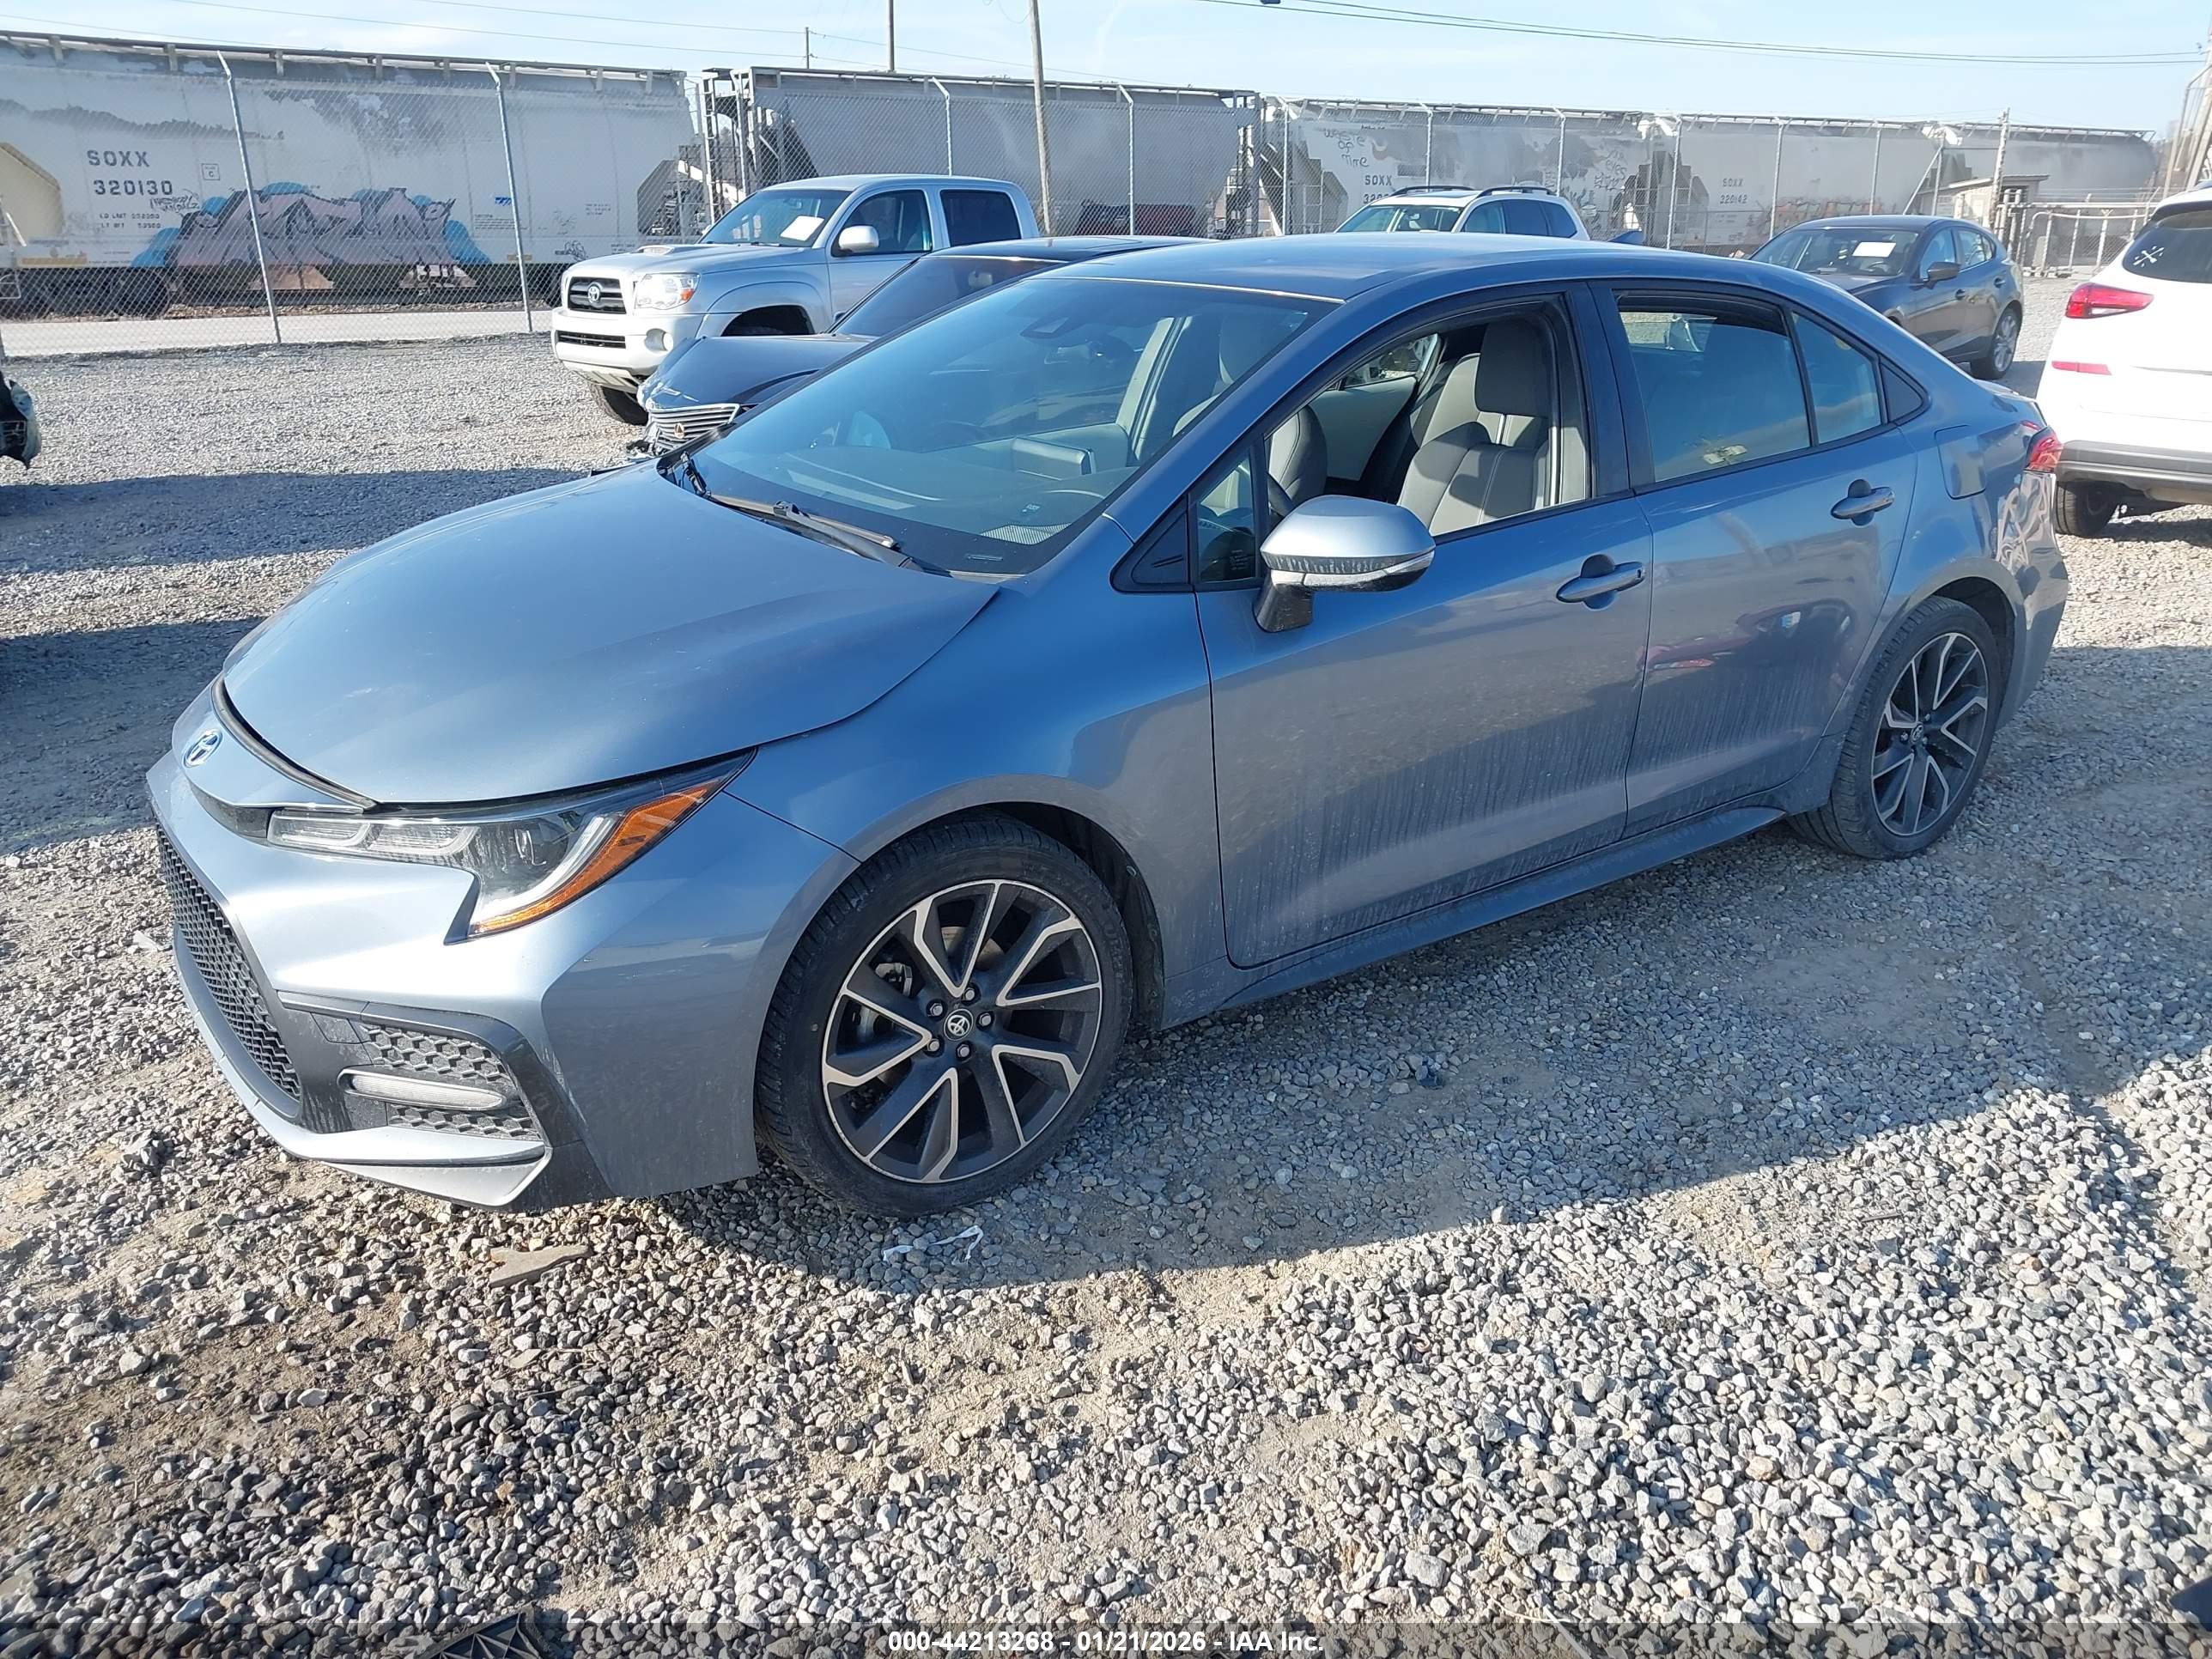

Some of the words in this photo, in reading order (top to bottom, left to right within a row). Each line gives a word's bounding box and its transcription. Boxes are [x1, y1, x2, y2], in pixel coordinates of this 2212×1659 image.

[87, 149, 149, 167] SOXX
[1364, 174, 1392, 186] SOXX
[1722, 178, 1743, 187] SOXX
[94, 179, 173, 196] 320130
[1363, 193, 1390, 204] 320
